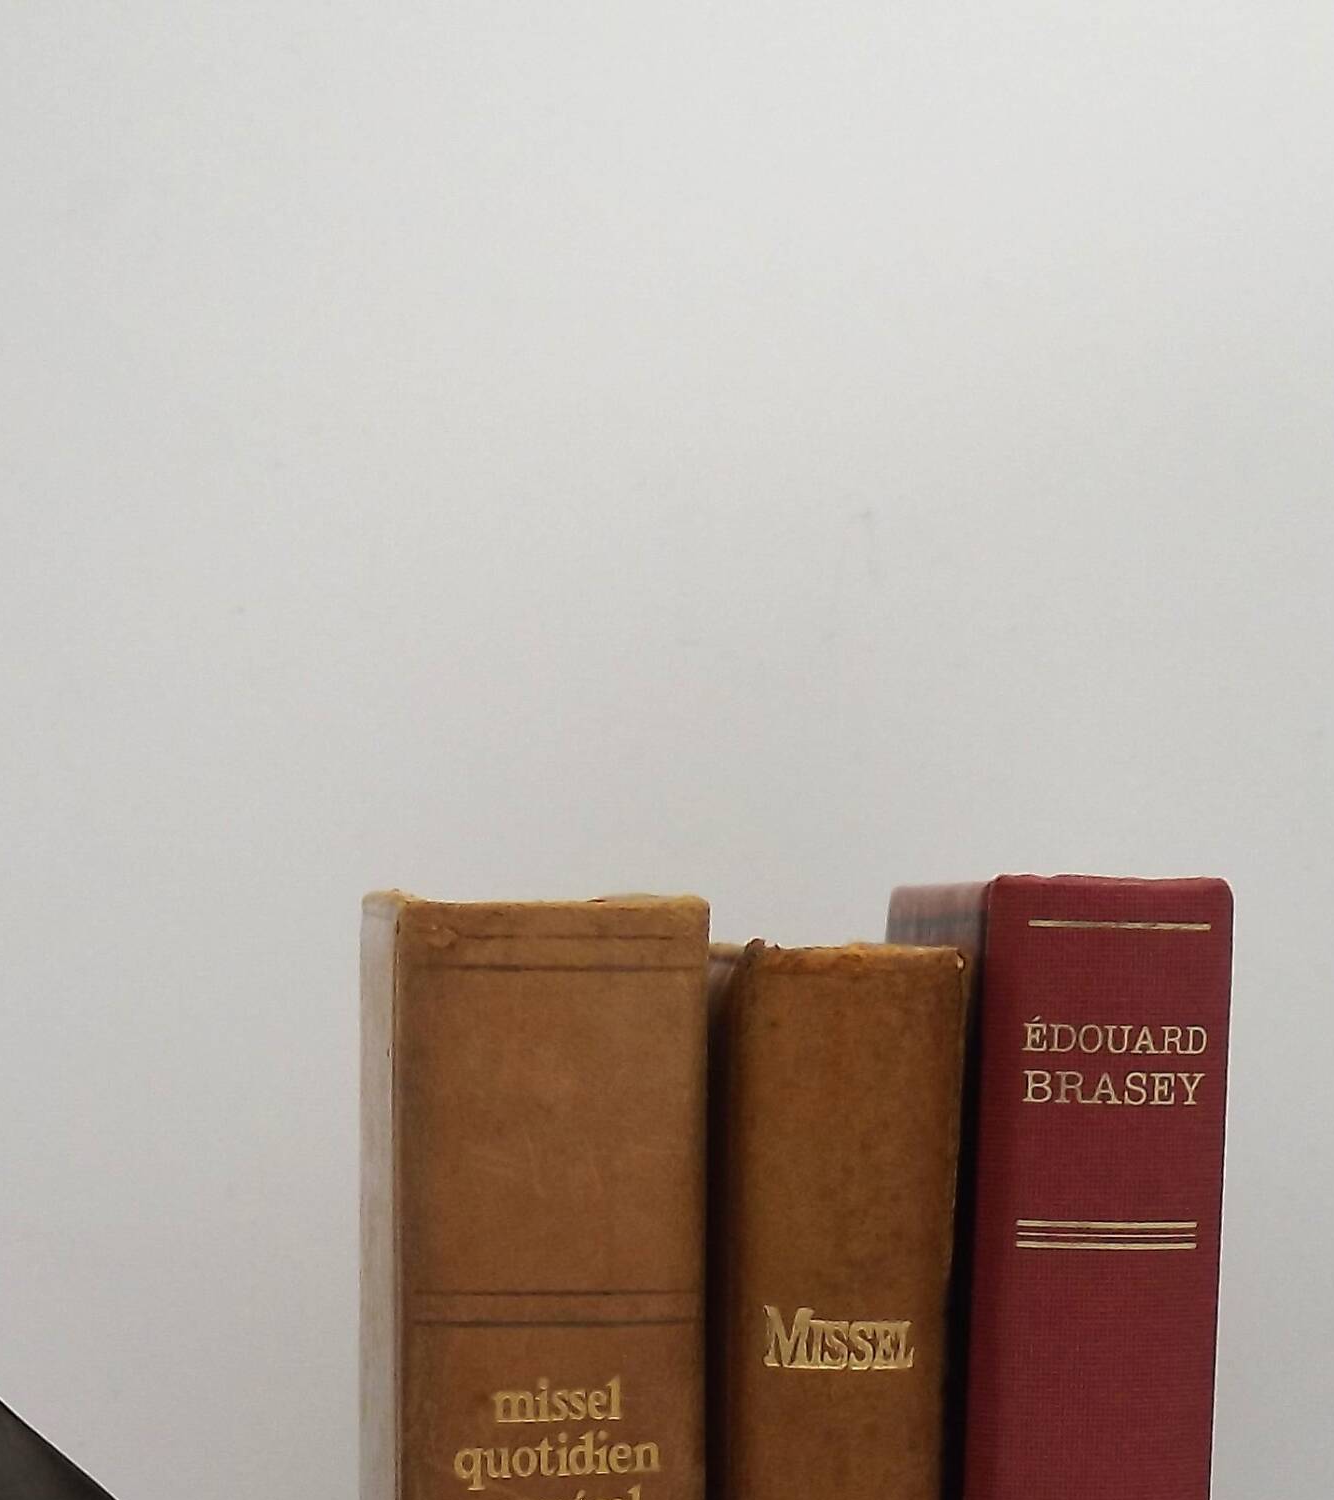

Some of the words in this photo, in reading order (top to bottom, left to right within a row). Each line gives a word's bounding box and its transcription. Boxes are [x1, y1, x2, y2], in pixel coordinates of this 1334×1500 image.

[1022, 1015, 1208, 1055] ÉDOUARD
[1022, 1070, 1206, 1105] BRASEY
[492, 1375, 622, 1423] missel
[453, 1430, 660, 1491] quotidien
